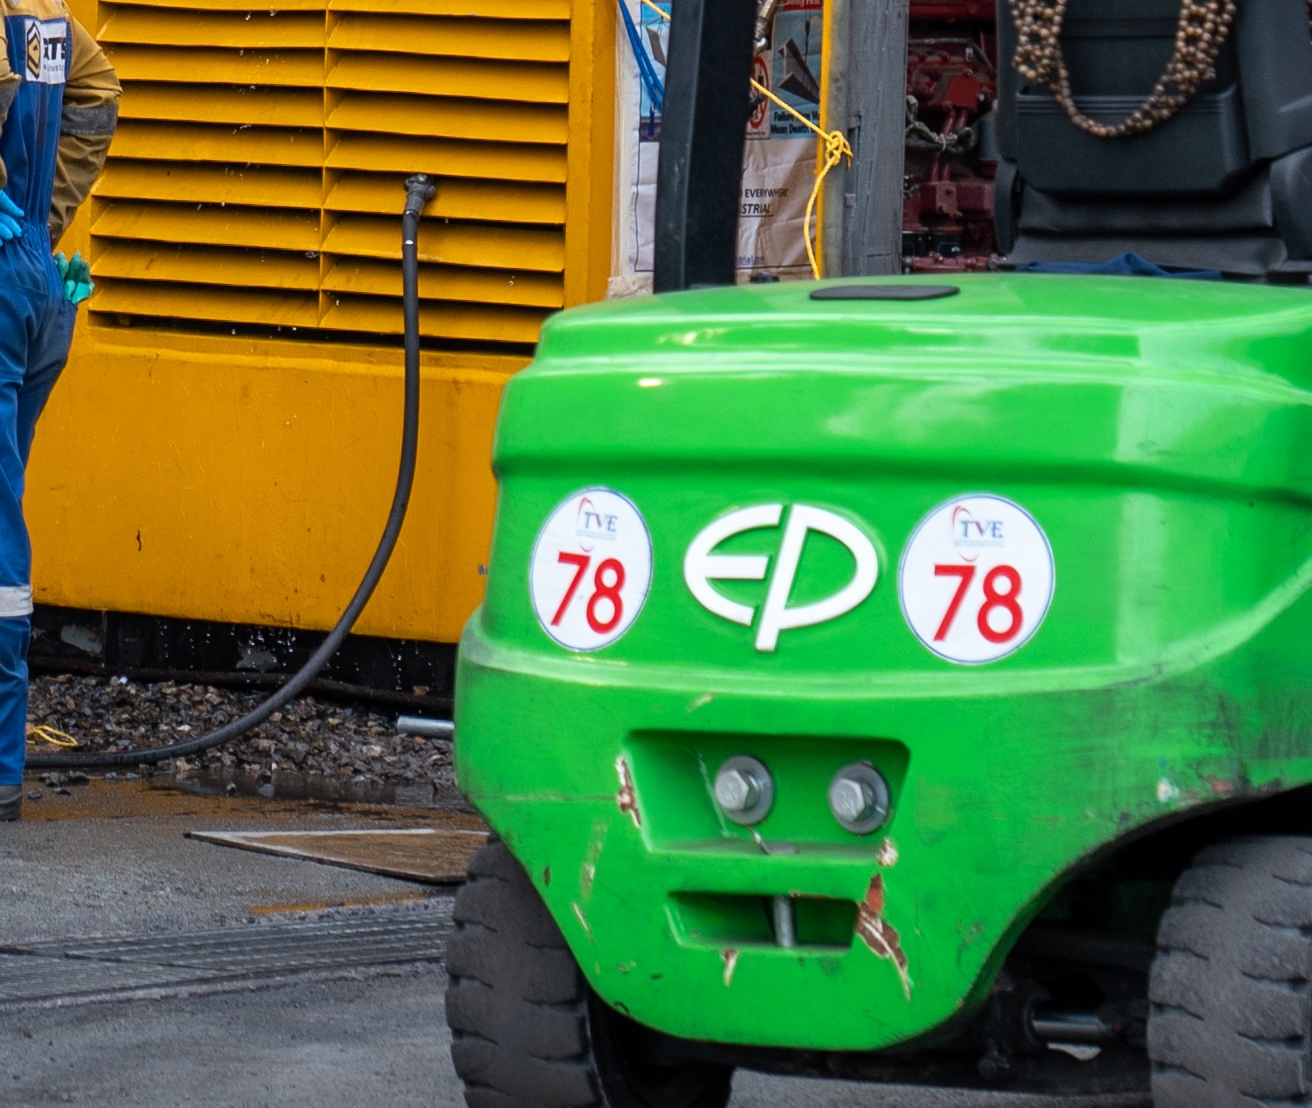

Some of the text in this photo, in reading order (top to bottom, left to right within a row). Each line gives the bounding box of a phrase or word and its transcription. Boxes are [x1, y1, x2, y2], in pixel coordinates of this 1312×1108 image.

[742, 203, 771, 215] STRIAL
[584, 511, 618, 533] TVE
[960, 520, 1004, 539] TVE
[550, 551, 626, 634] 78
[683, 502, 880, 652] EP
[933, 564, 1023, 644] 78
